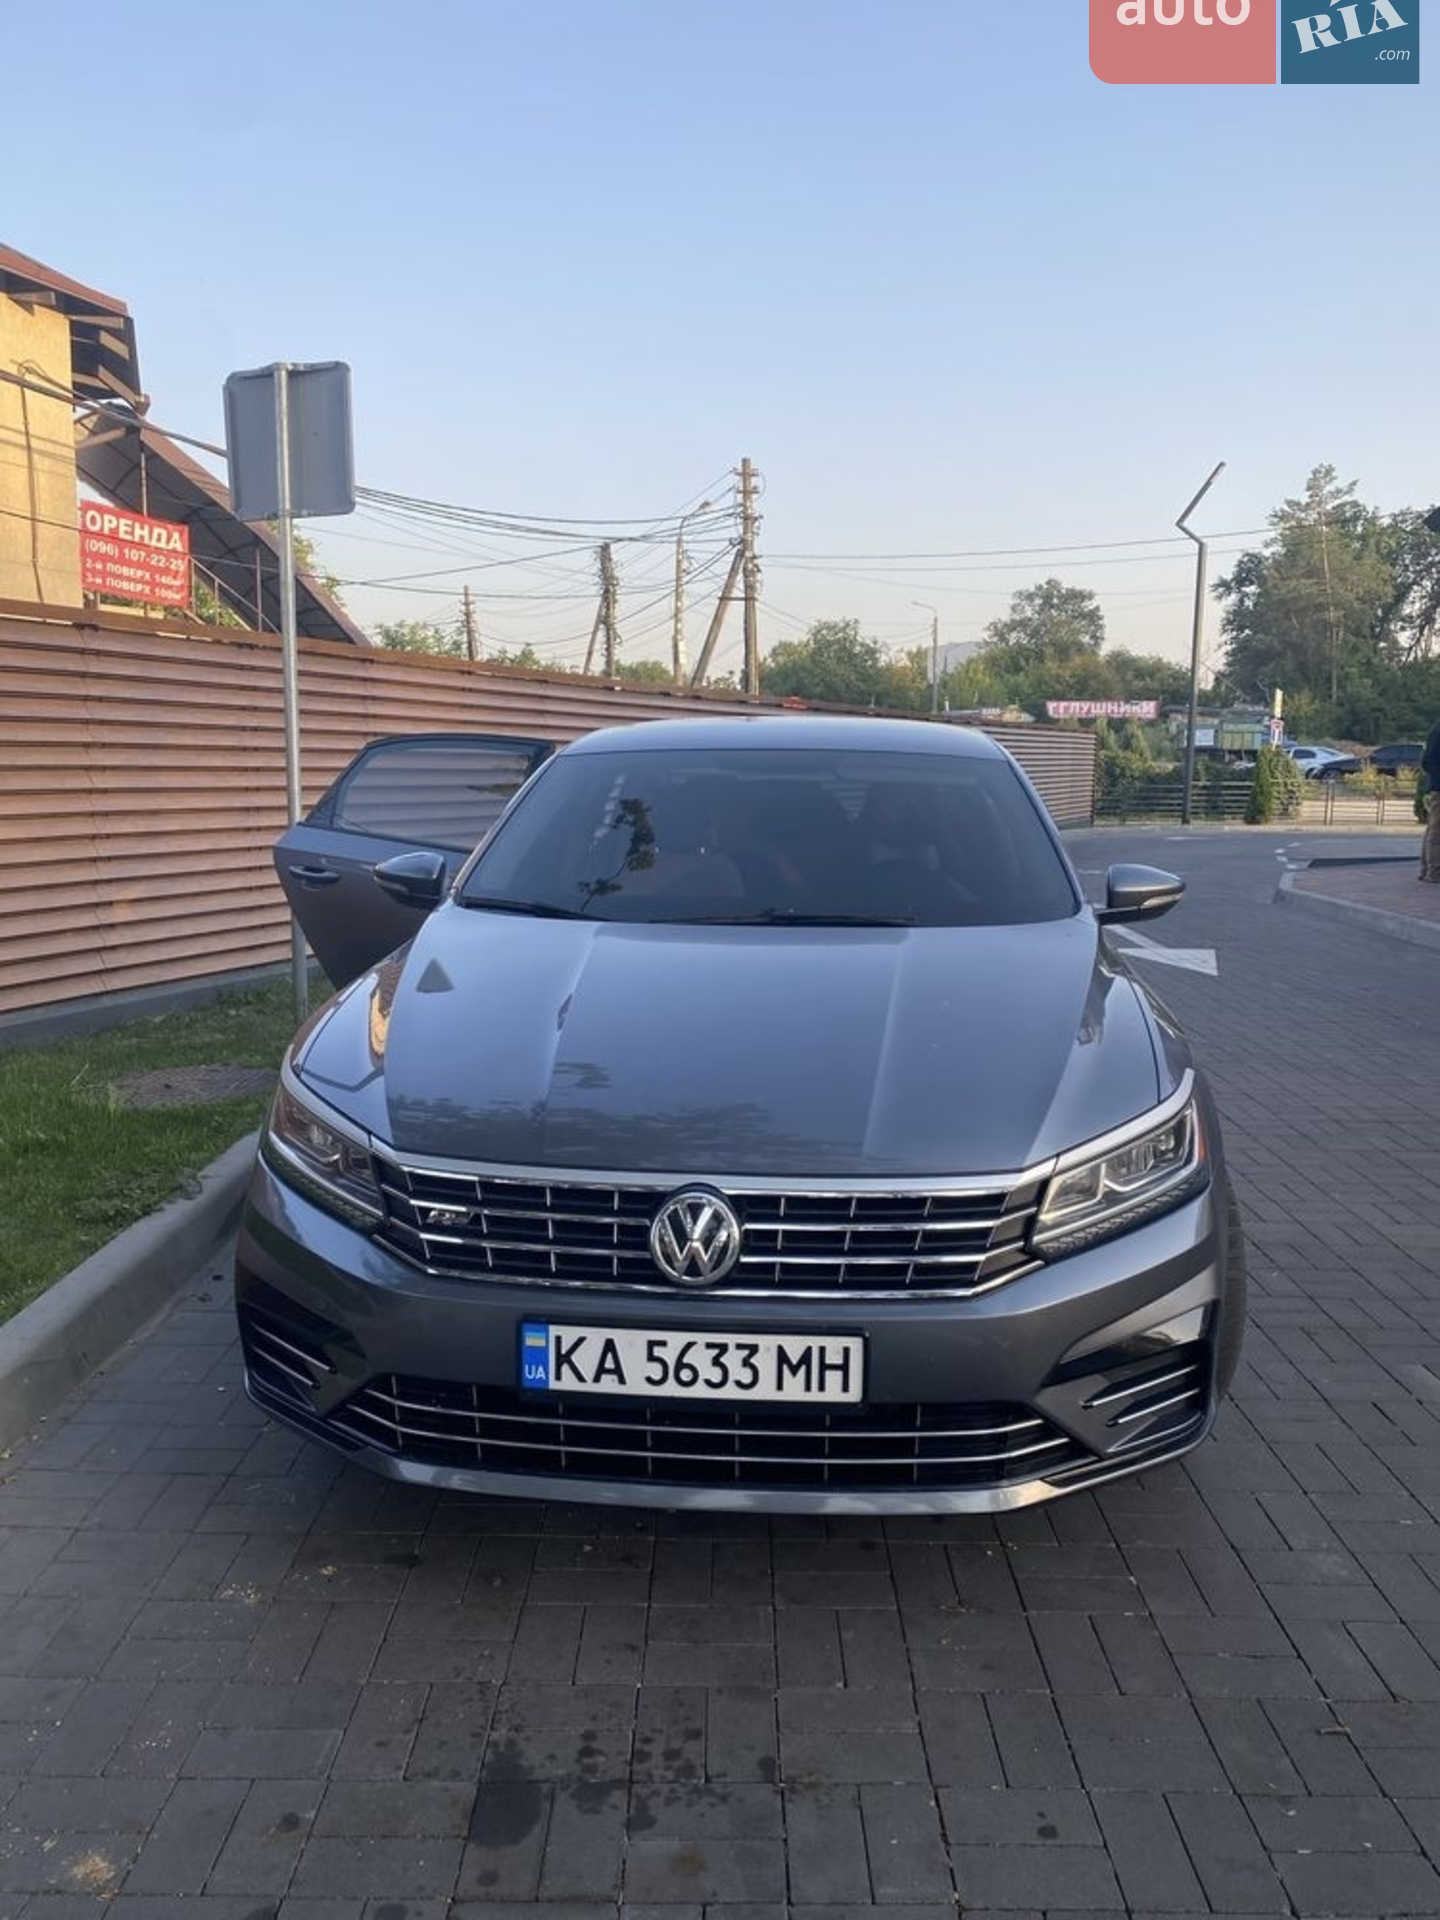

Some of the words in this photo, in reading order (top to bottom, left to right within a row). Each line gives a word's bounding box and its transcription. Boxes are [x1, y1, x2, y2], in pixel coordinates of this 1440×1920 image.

[85, 509, 183, 551] ОРЕНДА
[85, 538, 119, 558] (096)
[106, 562, 150, 581] ПОВЕРХ
[106, 577, 150, 595] ПОВЕРХ
[525, 1363, 546, 1380] UA
[554, 1334, 627, 1385] KA
[644, 1339, 760, 1390] 5633
[776, 1344, 850, 1393] MH
